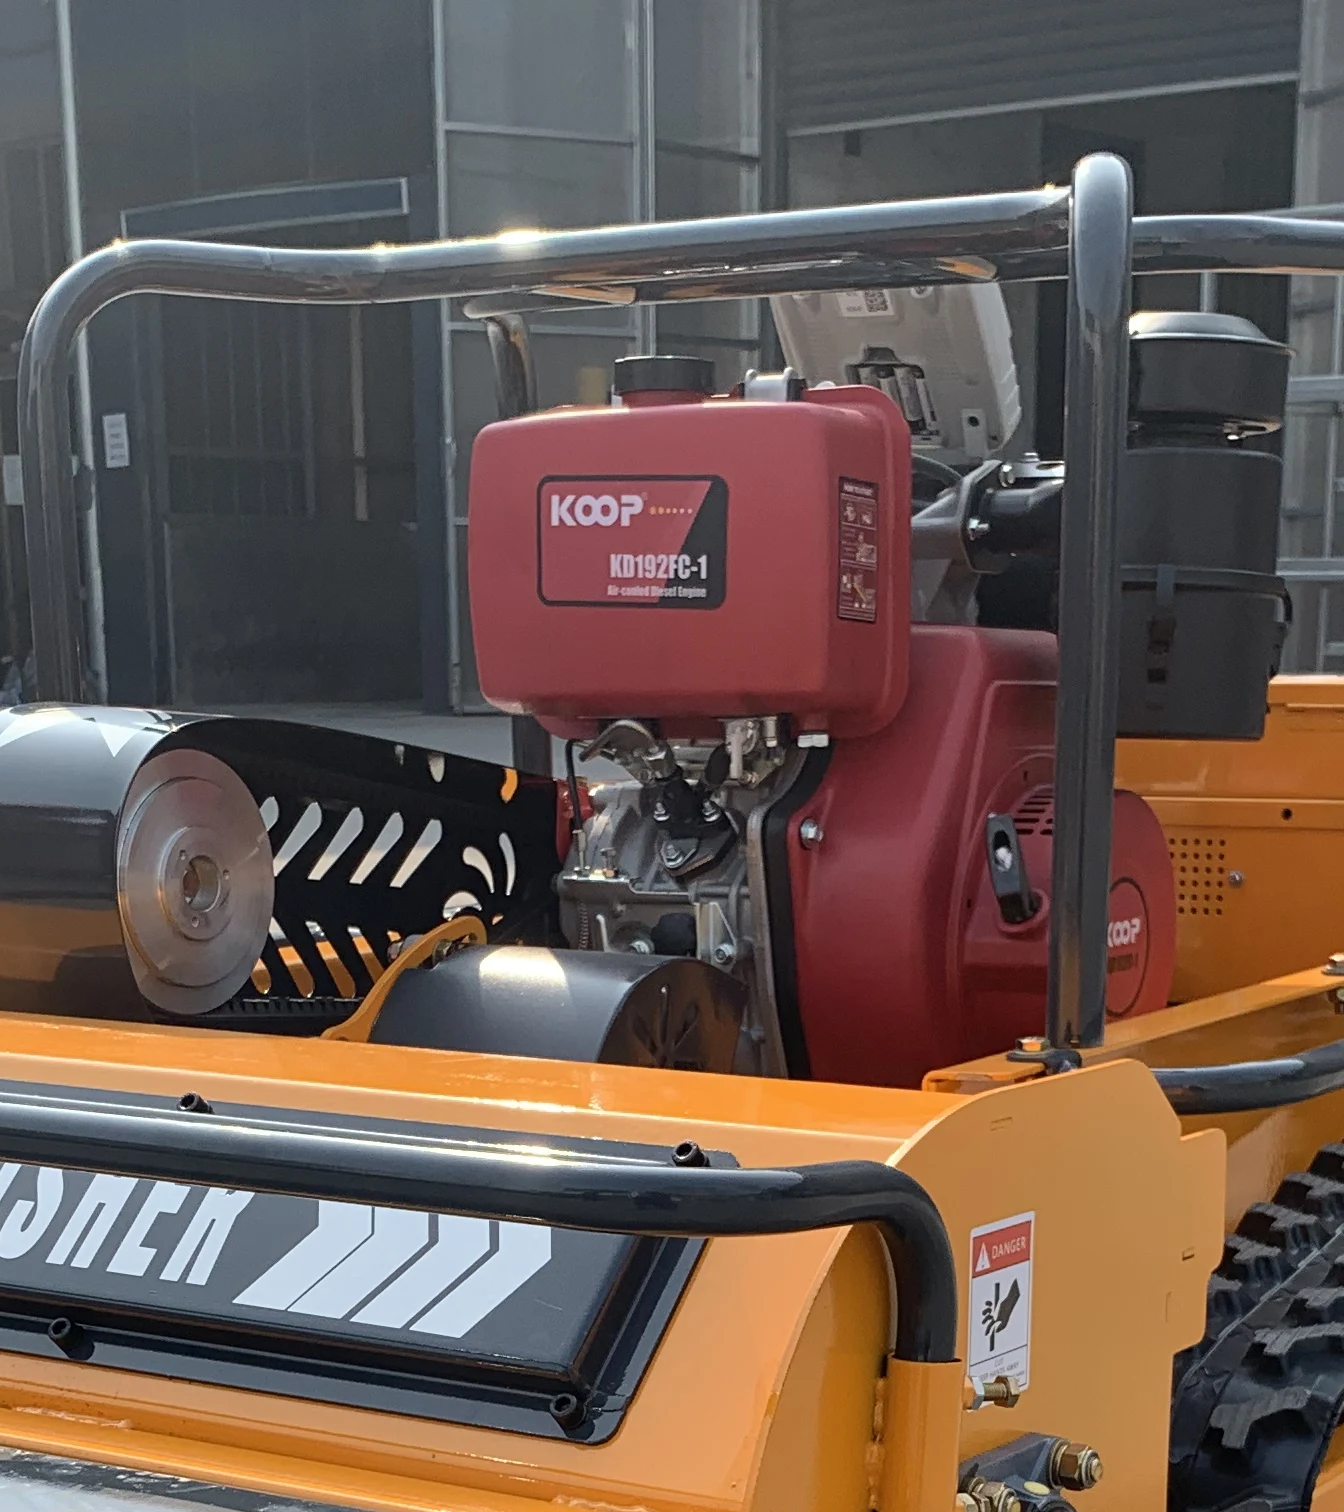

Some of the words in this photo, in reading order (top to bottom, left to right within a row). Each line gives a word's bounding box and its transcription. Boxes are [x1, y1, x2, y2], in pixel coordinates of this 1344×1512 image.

[550, 494, 645, 527] KOOP
[609, 553, 708, 580] KD192FC-1
[678, 586, 707, 599] Engine
[991, 1236, 1027, 1260] DANGER
